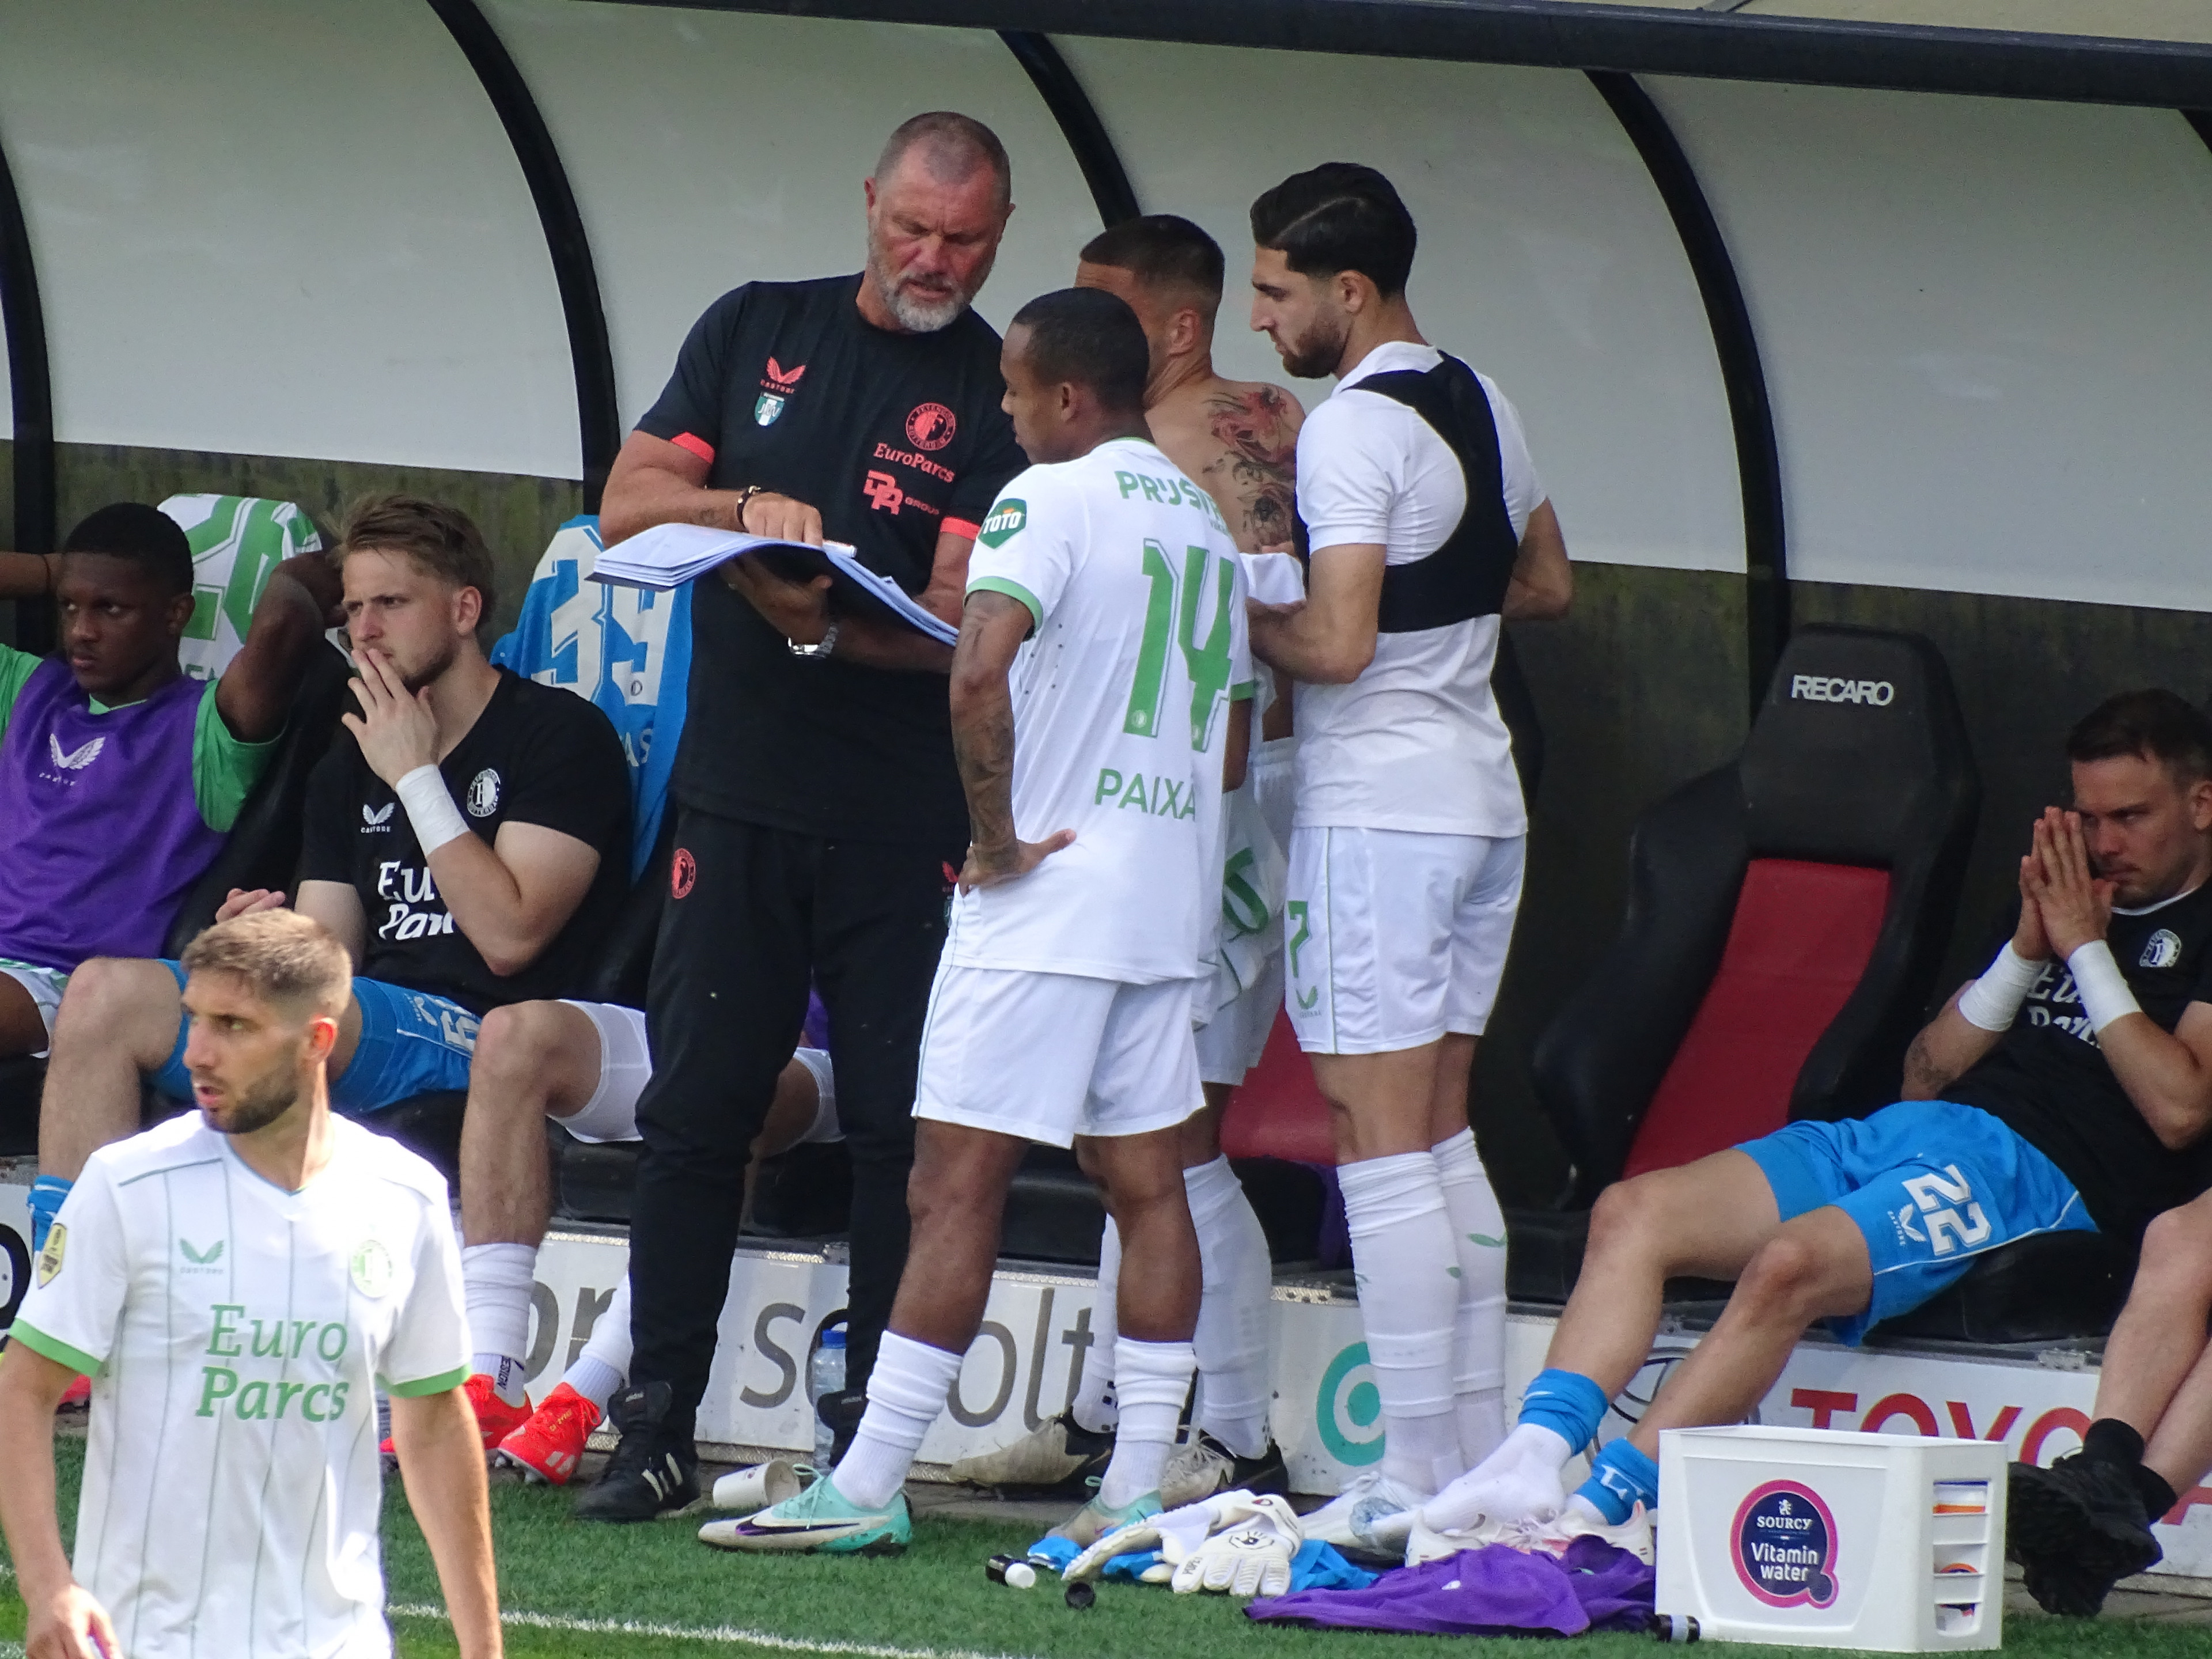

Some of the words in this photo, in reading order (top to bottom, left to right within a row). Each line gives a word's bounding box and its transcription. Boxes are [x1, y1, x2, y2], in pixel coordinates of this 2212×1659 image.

[873, 442, 956, 483] EuroParcs
[983, 512, 1022, 534] TOTO
[1123, 537, 1237, 753] 14
[1791, 675, 1894, 706] RECARO
[1094, 768, 1196, 823] PAIXA
[377, 860, 435, 903] Eu
[1287, 900, 1312, 979] 7
[2026, 963, 2082, 1004] Eu
[1901, 1164, 1993, 1256] 22
[204, 1304, 349, 1362] Euro
[496, 1354, 512, 1391] ESIGN
[195, 1365, 350, 1423] Parcs
[1757, 1516, 1813, 1531] SOURCY
[1751, 1541, 1819, 1565] Vitamin
[1760, 1563, 1809, 1582] water
